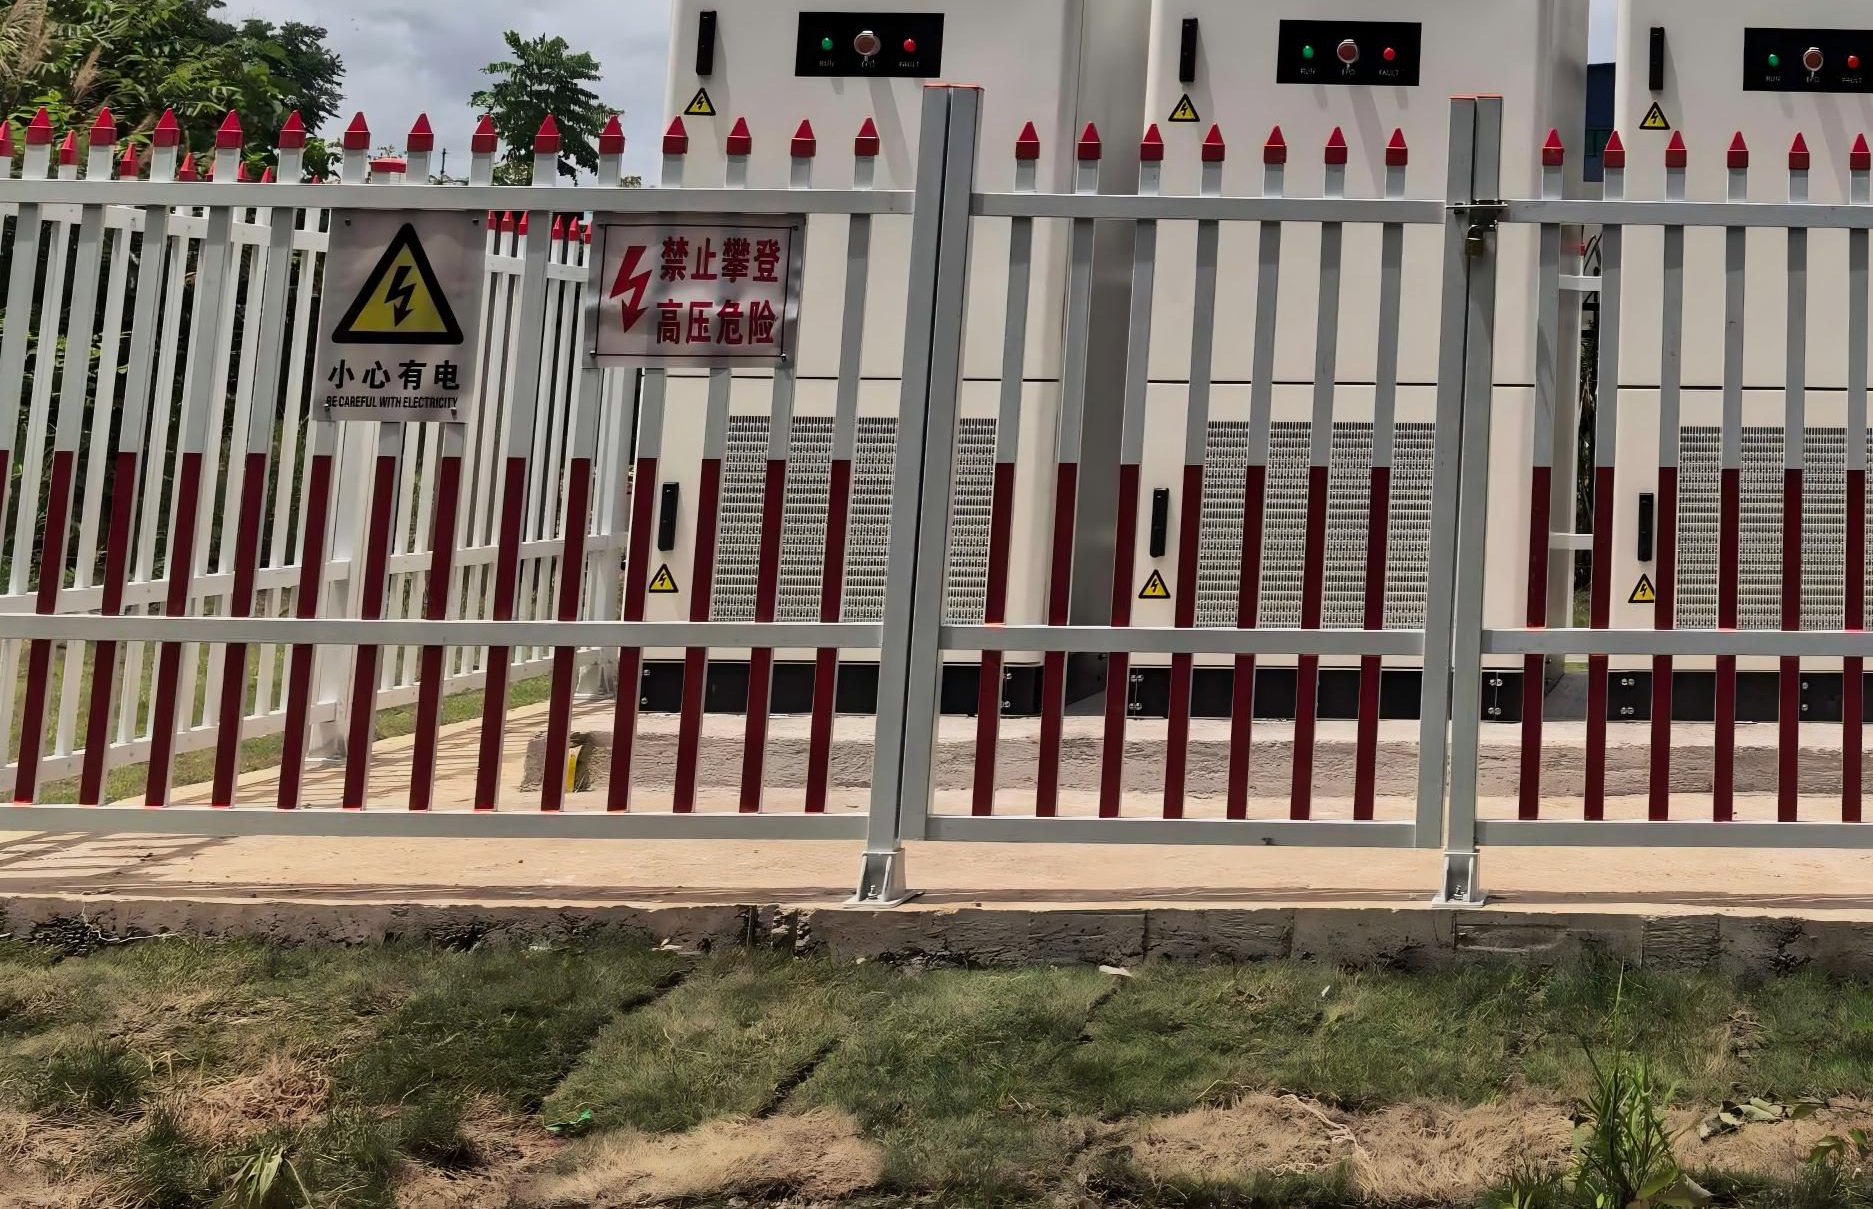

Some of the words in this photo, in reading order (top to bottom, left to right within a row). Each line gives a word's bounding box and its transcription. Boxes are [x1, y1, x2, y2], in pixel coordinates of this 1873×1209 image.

[660, 236, 780, 283] 禁止攀登
[657, 299, 777, 344] 高压危险
[327, 359, 460, 390] 小心有电
[326, 395, 338, 407] BE
[338, 396, 378, 408] CAREFUL
[379, 396, 401, 408] WITH
[402, 396, 458, 409] ELECTRICITY
